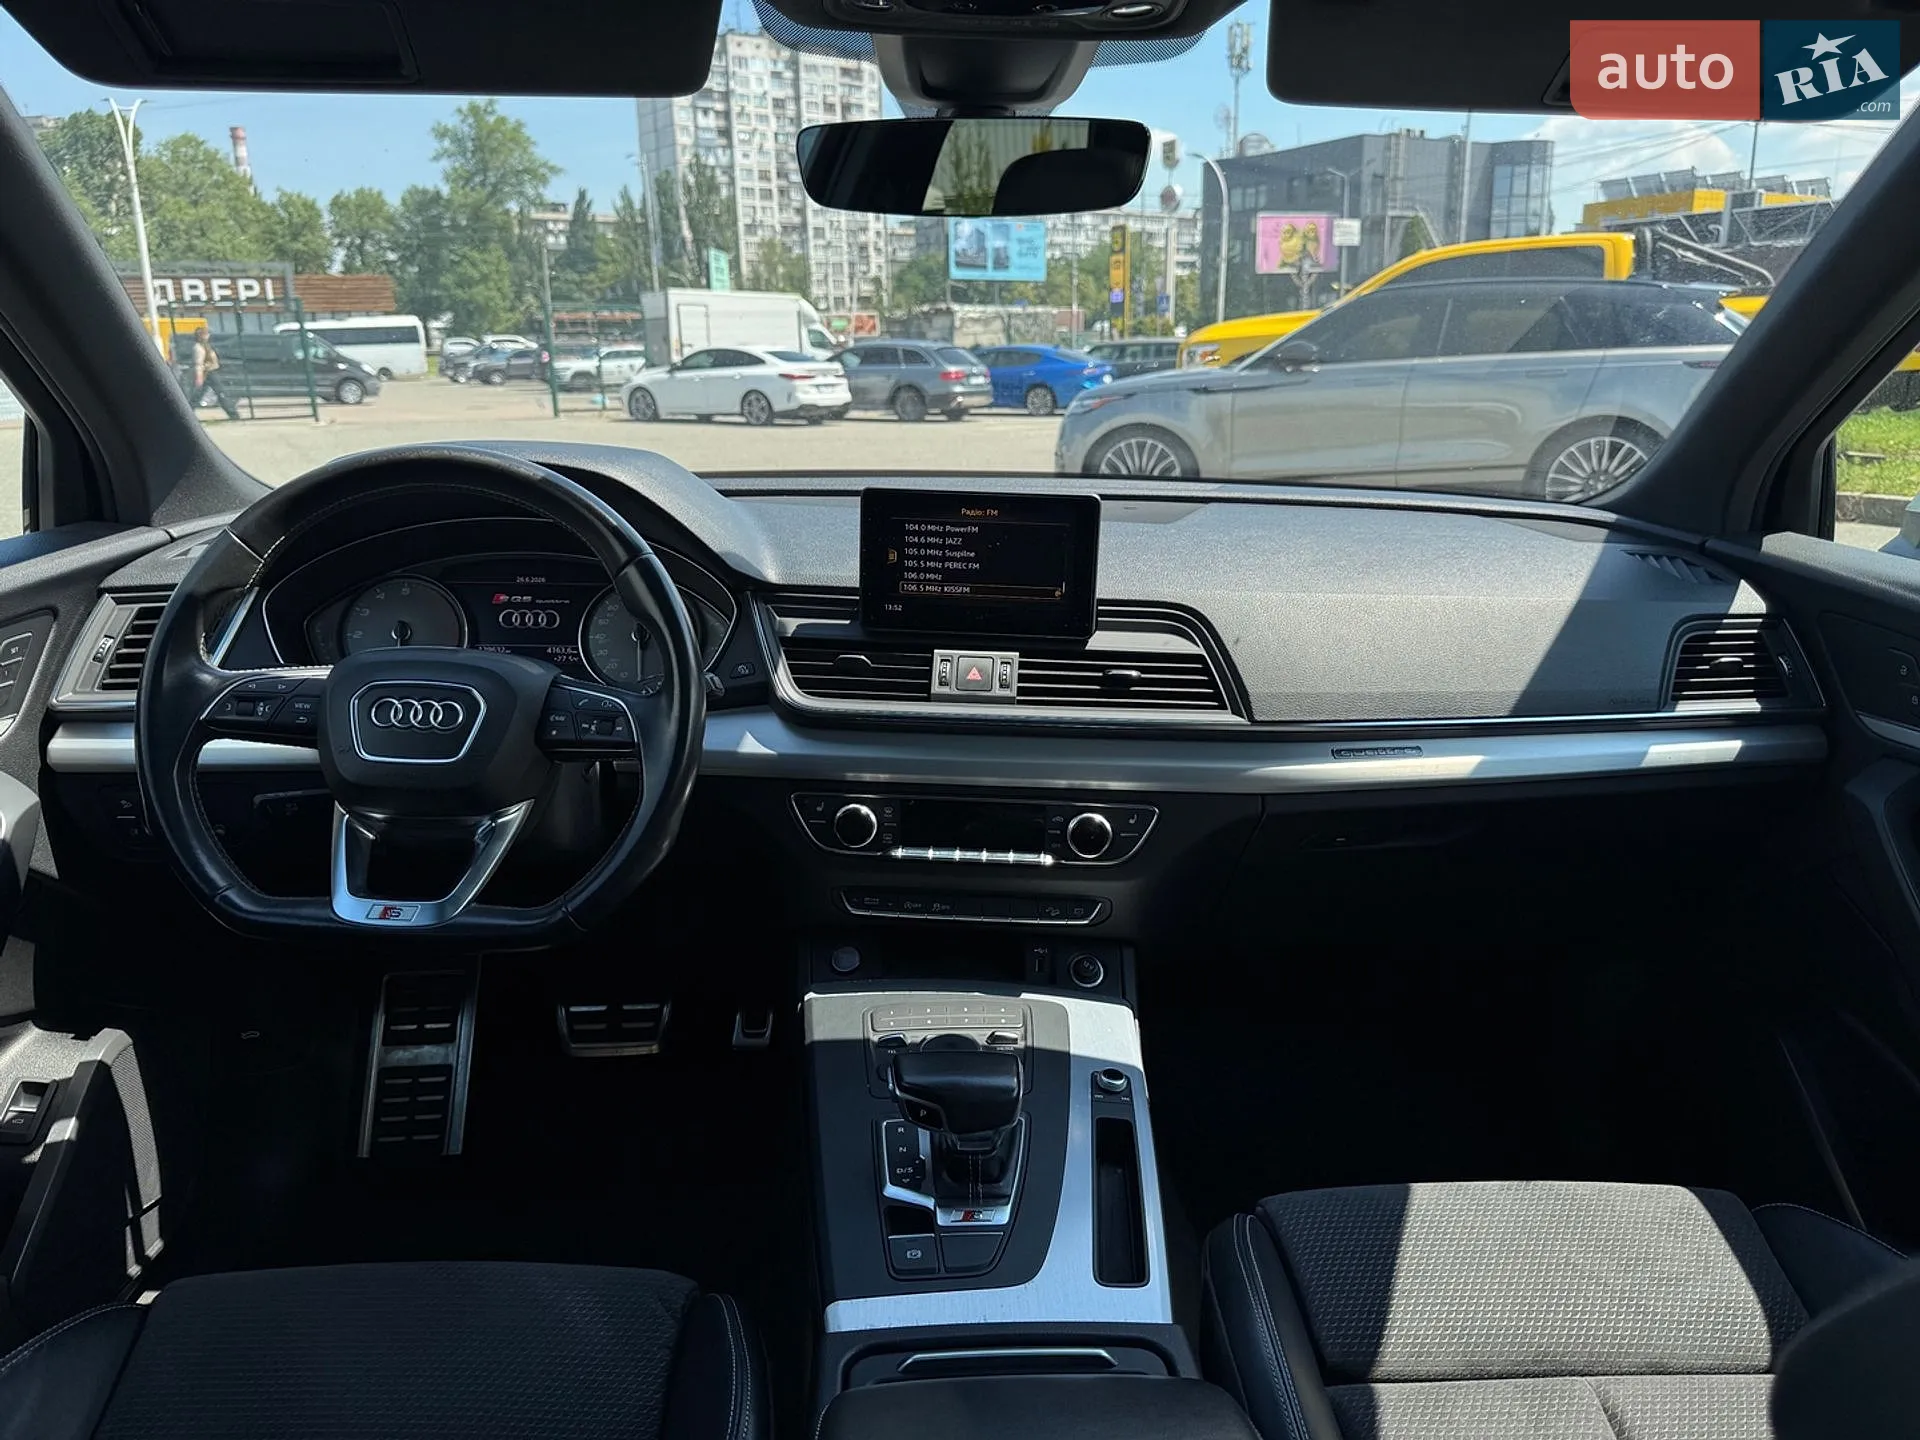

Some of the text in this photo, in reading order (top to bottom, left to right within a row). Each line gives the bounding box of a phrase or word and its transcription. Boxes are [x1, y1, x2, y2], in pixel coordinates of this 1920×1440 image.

[152, 278, 275, 307] ДВЕРІ
[904, 523, 926, 531] 104.0
[945, 525, 979, 533] PowerFM
[904, 535, 926, 544] 104.6
[945, 537, 963, 545] JAZZ
[904, 547, 925, 556] 105.0
[944, 549, 976, 558] Suspilne
[903, 572, 925, 580] 106.0
[919, 1108, 927, 1117] P
[896, 1166, 914, 1174] D/S
